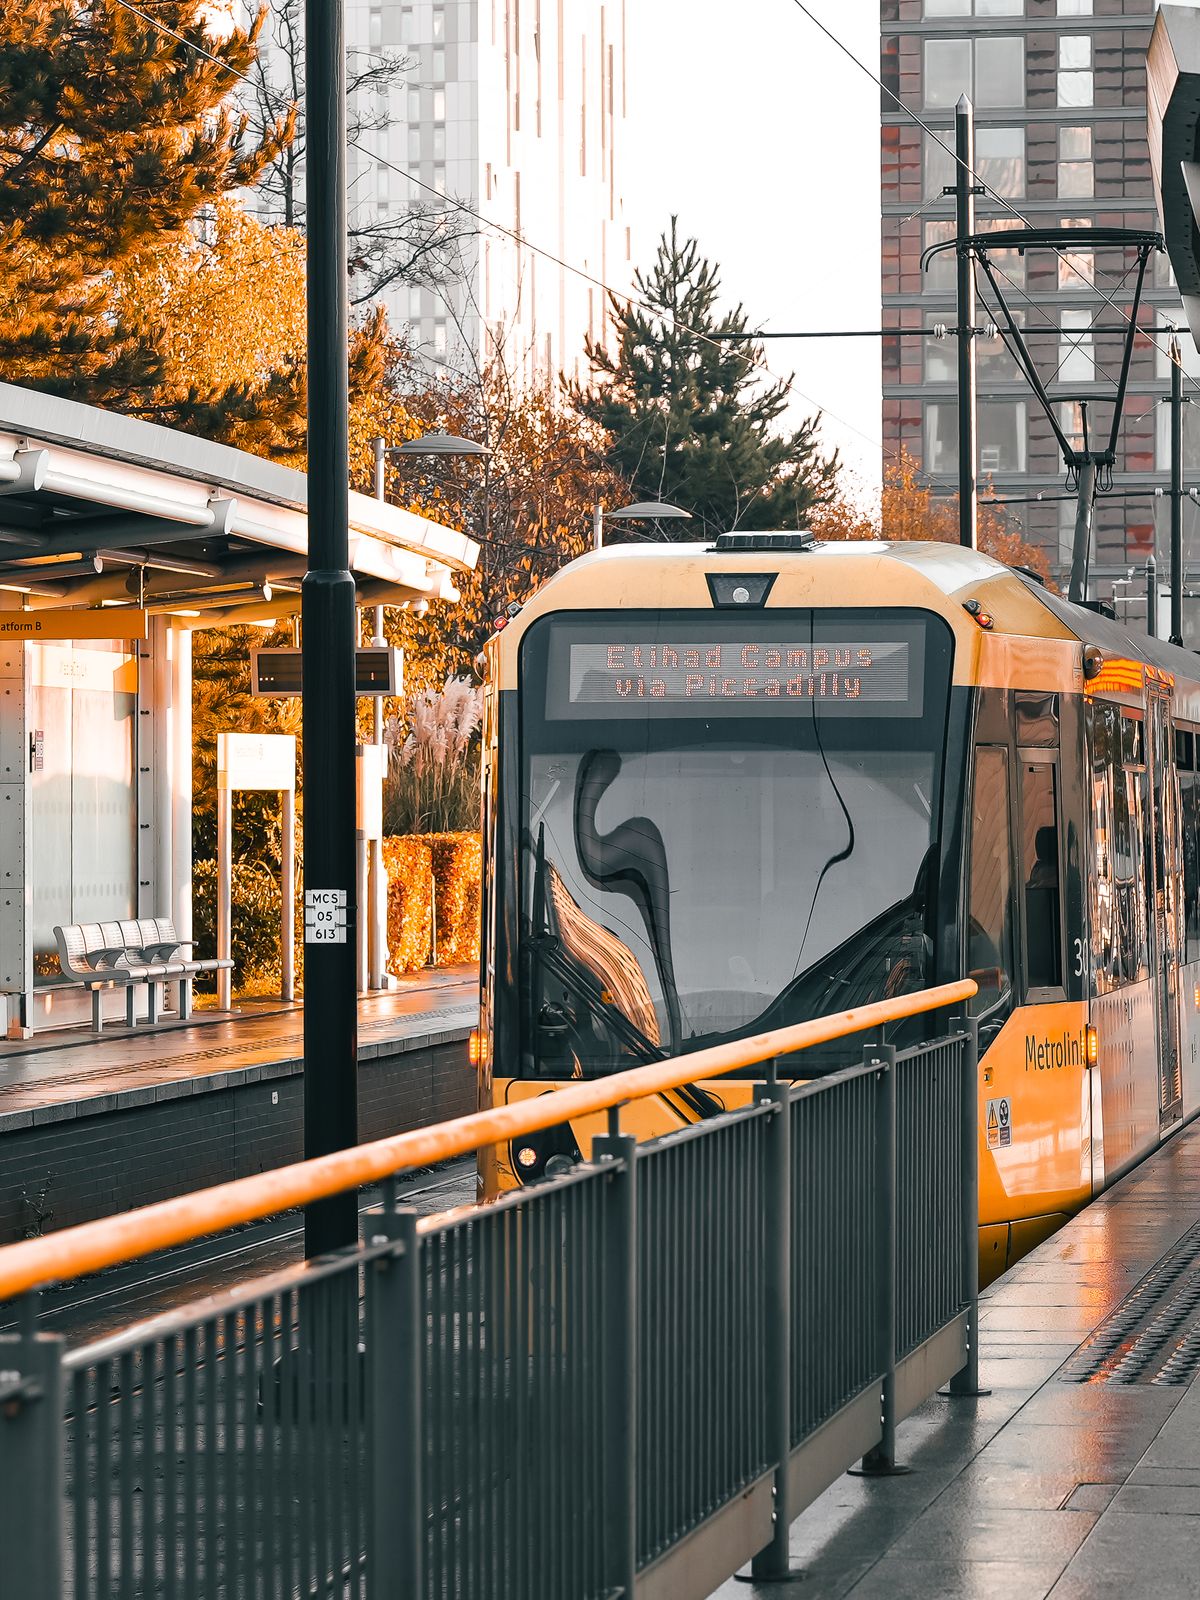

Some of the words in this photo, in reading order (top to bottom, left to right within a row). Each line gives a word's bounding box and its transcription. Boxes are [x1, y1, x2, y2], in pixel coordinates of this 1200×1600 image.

[35, 621, 42, 631] B
[606, 645, 721, 669] Etihad
[740, 644, 873, 670] Campus
[614, 674, 666, 698] via
[685, 673, 861, 699] Piccadilly
[312, 893, 339, 904] MCS
[317, 911, 333, 922] 05
[315, 928, 336, 940] 613
